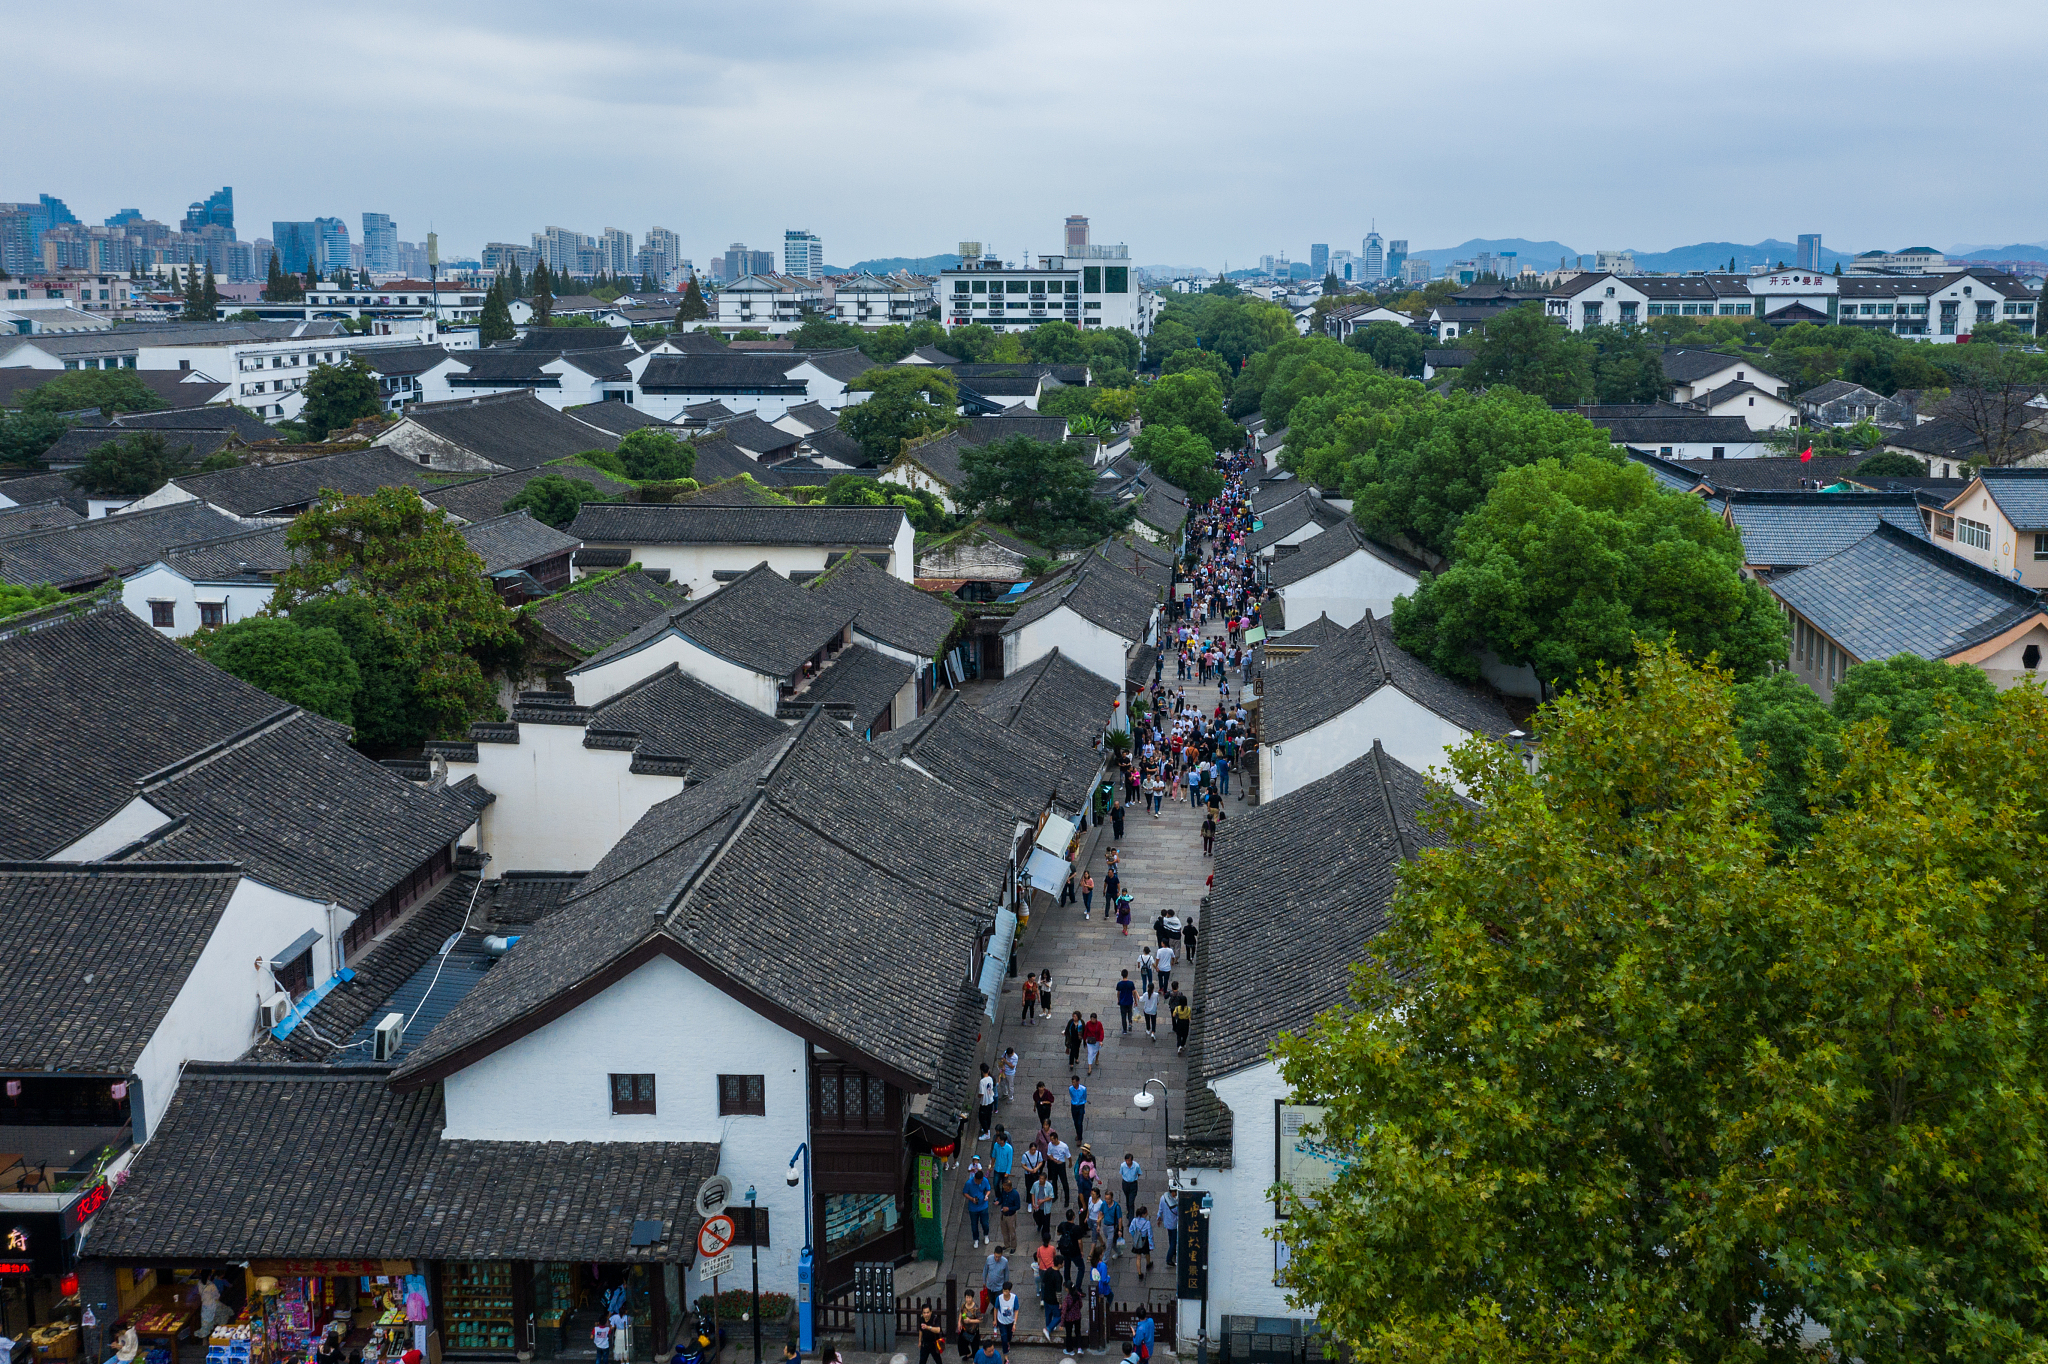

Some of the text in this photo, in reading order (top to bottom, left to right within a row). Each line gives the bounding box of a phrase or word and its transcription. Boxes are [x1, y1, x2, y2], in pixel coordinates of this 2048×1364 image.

[1184, 1201, 1201, 1289] 鲁迅故里景区
